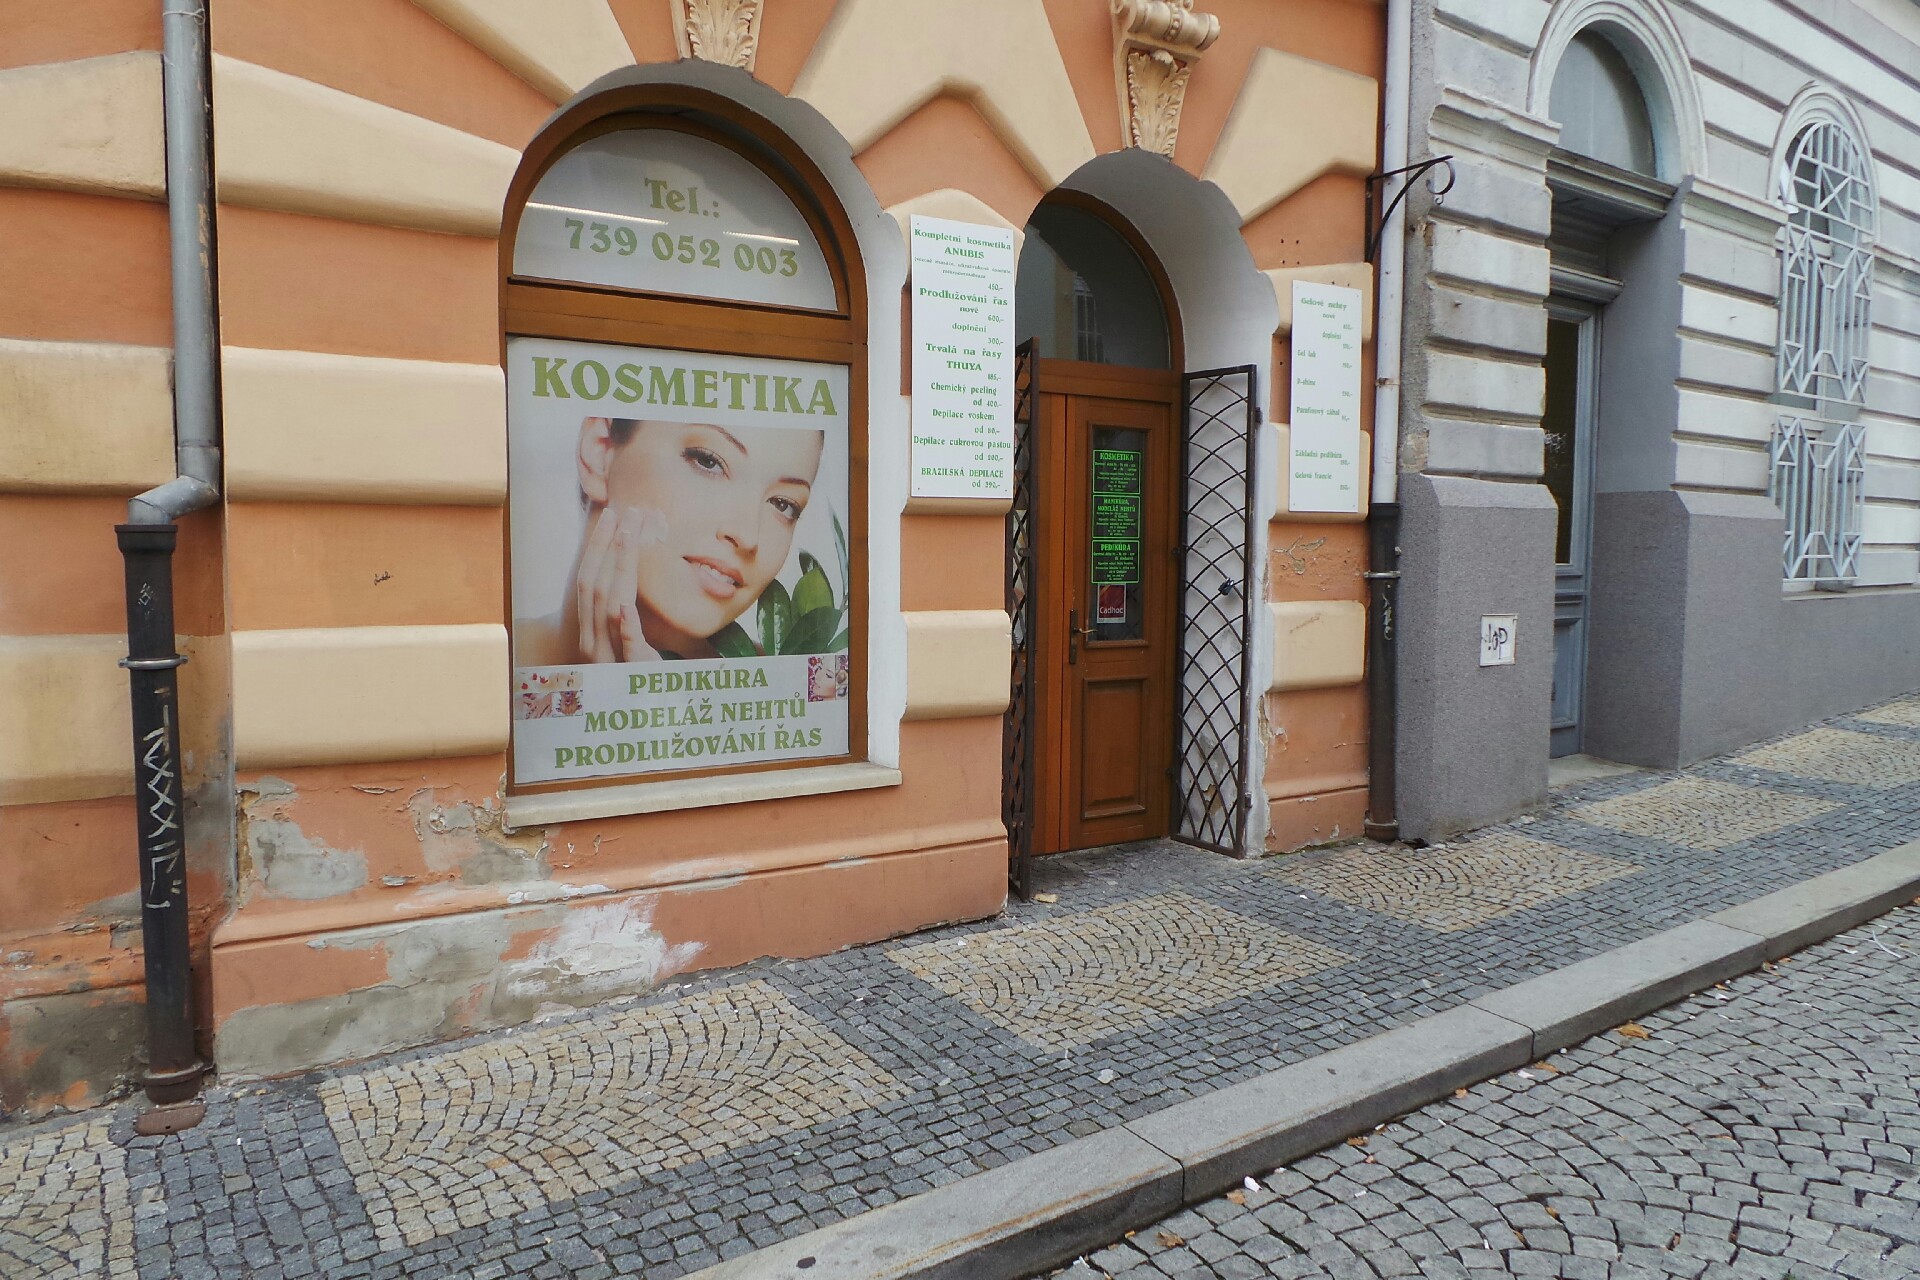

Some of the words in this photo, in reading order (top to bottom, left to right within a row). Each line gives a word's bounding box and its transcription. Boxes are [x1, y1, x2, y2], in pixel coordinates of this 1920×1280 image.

[644, 177, 720, 218] Tel.:
[565, 218, 637, 256] 739
[652, 231, 720, 269] 052
[734, 243, 798, 277] 003
[966, 236, 1011, 250] kosmetika
[944, 246, 985, 259] ANUBIS
[987, 283, 1004, 292] 450,-
[919, 287, 987, 304] Prodlužování
[993, 296, 1008, 306] řas
[959, 305, 979, 314] nové
[925, 343, 957, 354] Trvalá
[963, 348, 976, 356] na
[982, 347, 1002, 359] řasy
[946, 360, 982, 371] THUYA
[531, 356, 838, 416] KOSMETIKA
[930, 382, 966, 394] Chemický
[970, 386, 997, 396] peeling
[973, 398, 983, 406] od
[932, 408, 964, 419] Depilace
[968, 412, 995, 421] voskem
[974, 425, 984, 434] od
[913, 435, 945, 446] Depilace
[949, 438, 984, 447] cukrovou
[987, 440, 1011, 450] pastou
[974, 452, 984, 461] od
[1100, 452, 1134, 461] KOSMETIKA
[921, 466, 965, 477] BRAZILSKÁ
[969, 469, 1004, 478] DEPILACE
[972, 479, 981, 488] od
[1099, 606, 1124, 615] Cadhoc
[628, 661, 768, 695] PEDIKÚRA
[584, 698, 713, 733] MODELÁŽ
[720, 691, 807, 723] NEHTŮ
[554, 724, 766, 769] PRODLUŽOVÁNÍ
[774, 723, 822, 749] ŘAS
